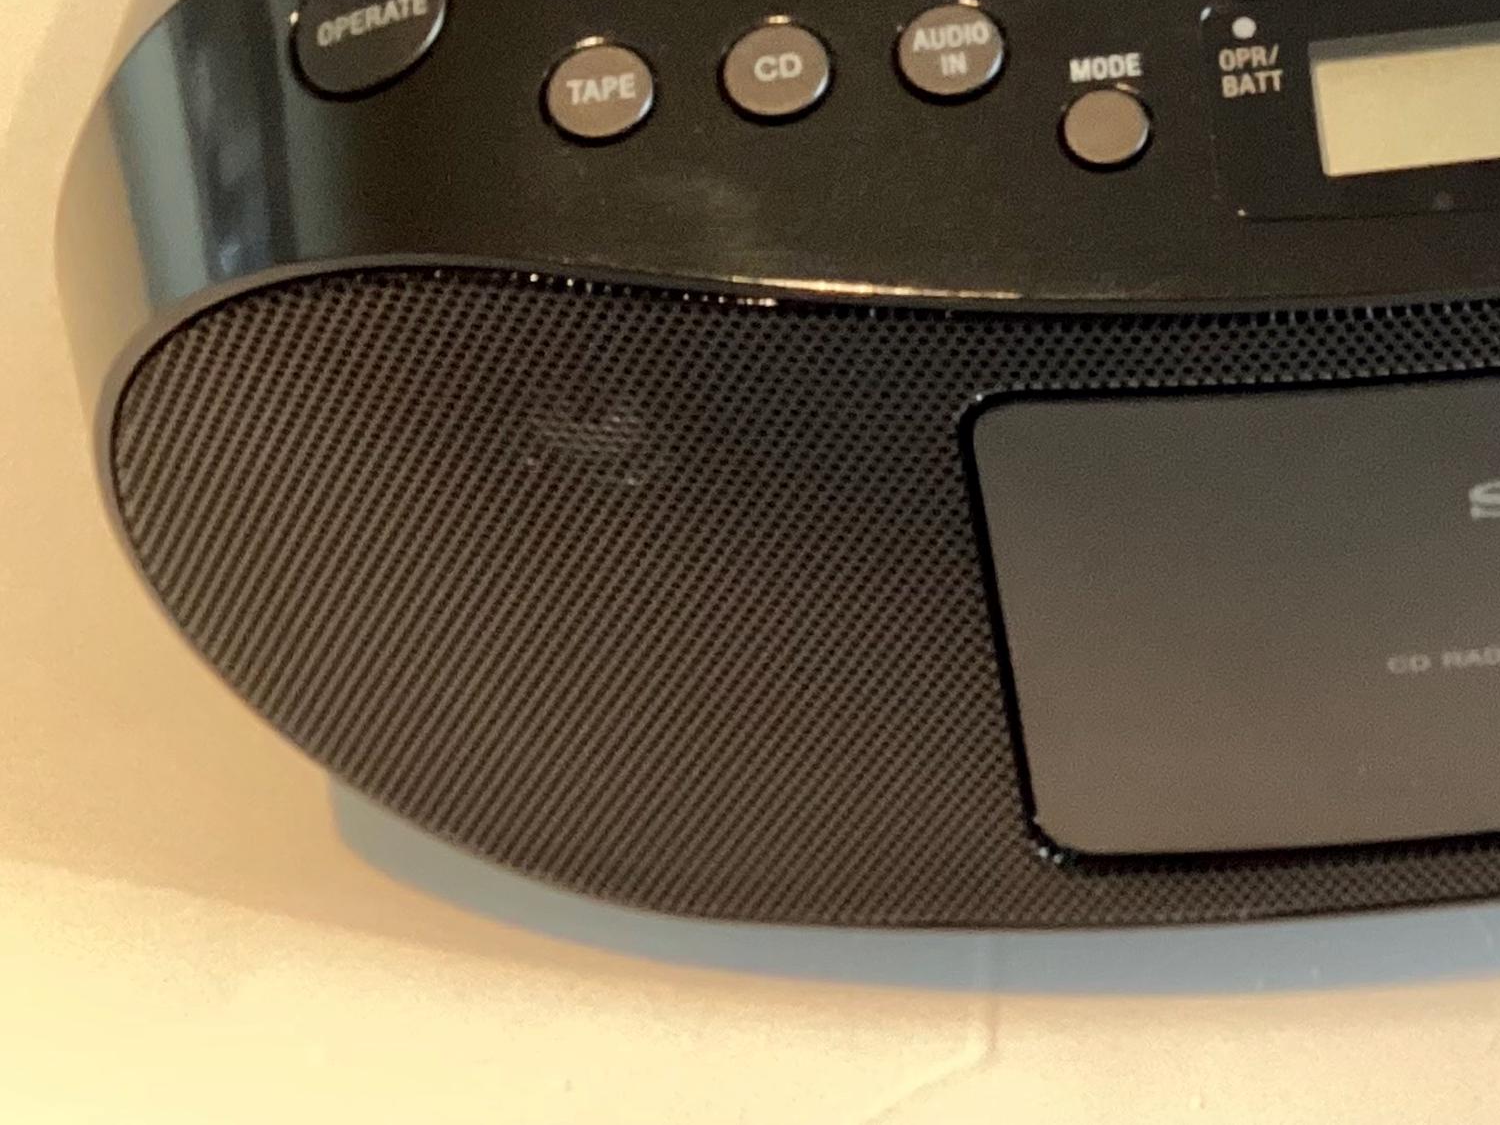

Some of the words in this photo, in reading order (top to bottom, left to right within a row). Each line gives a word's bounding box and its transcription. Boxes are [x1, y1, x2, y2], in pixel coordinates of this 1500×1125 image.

[912, 21, 991, 52] AUDIO
[754, 52, 803, 81] CD
[938, 52, 968, 76] IN
[1069, 52, 1142, 83] MODE
[1218, 43, 1279, 72] OPR/
[566, 73, 637, 105] TAPE
[1222, 68, 1283, 98] BATT
[1386, 653, 1432, 673] CD
